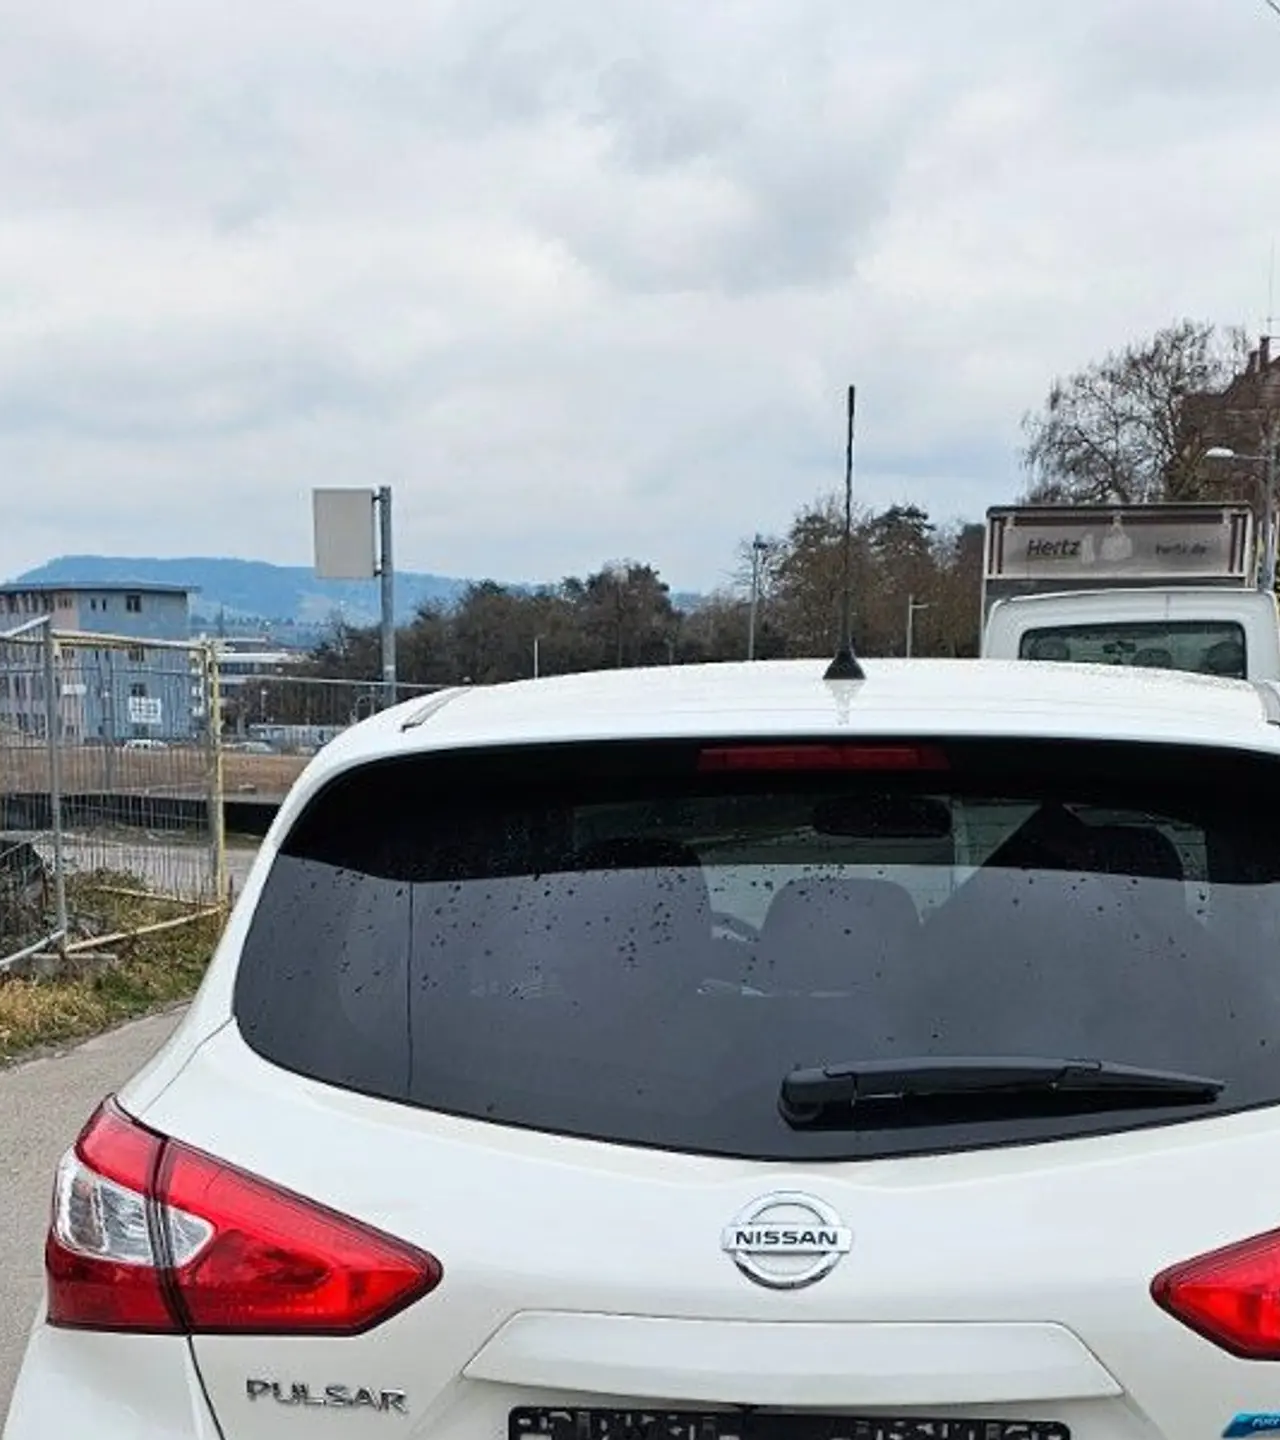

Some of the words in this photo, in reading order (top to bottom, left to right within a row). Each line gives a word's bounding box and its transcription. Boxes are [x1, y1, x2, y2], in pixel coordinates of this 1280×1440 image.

[1026, 538, 1081, 556] Hertz
[735, 1230, 838, 1246] NISSAN
[245, 1379, 409, 1415] PULSAR
